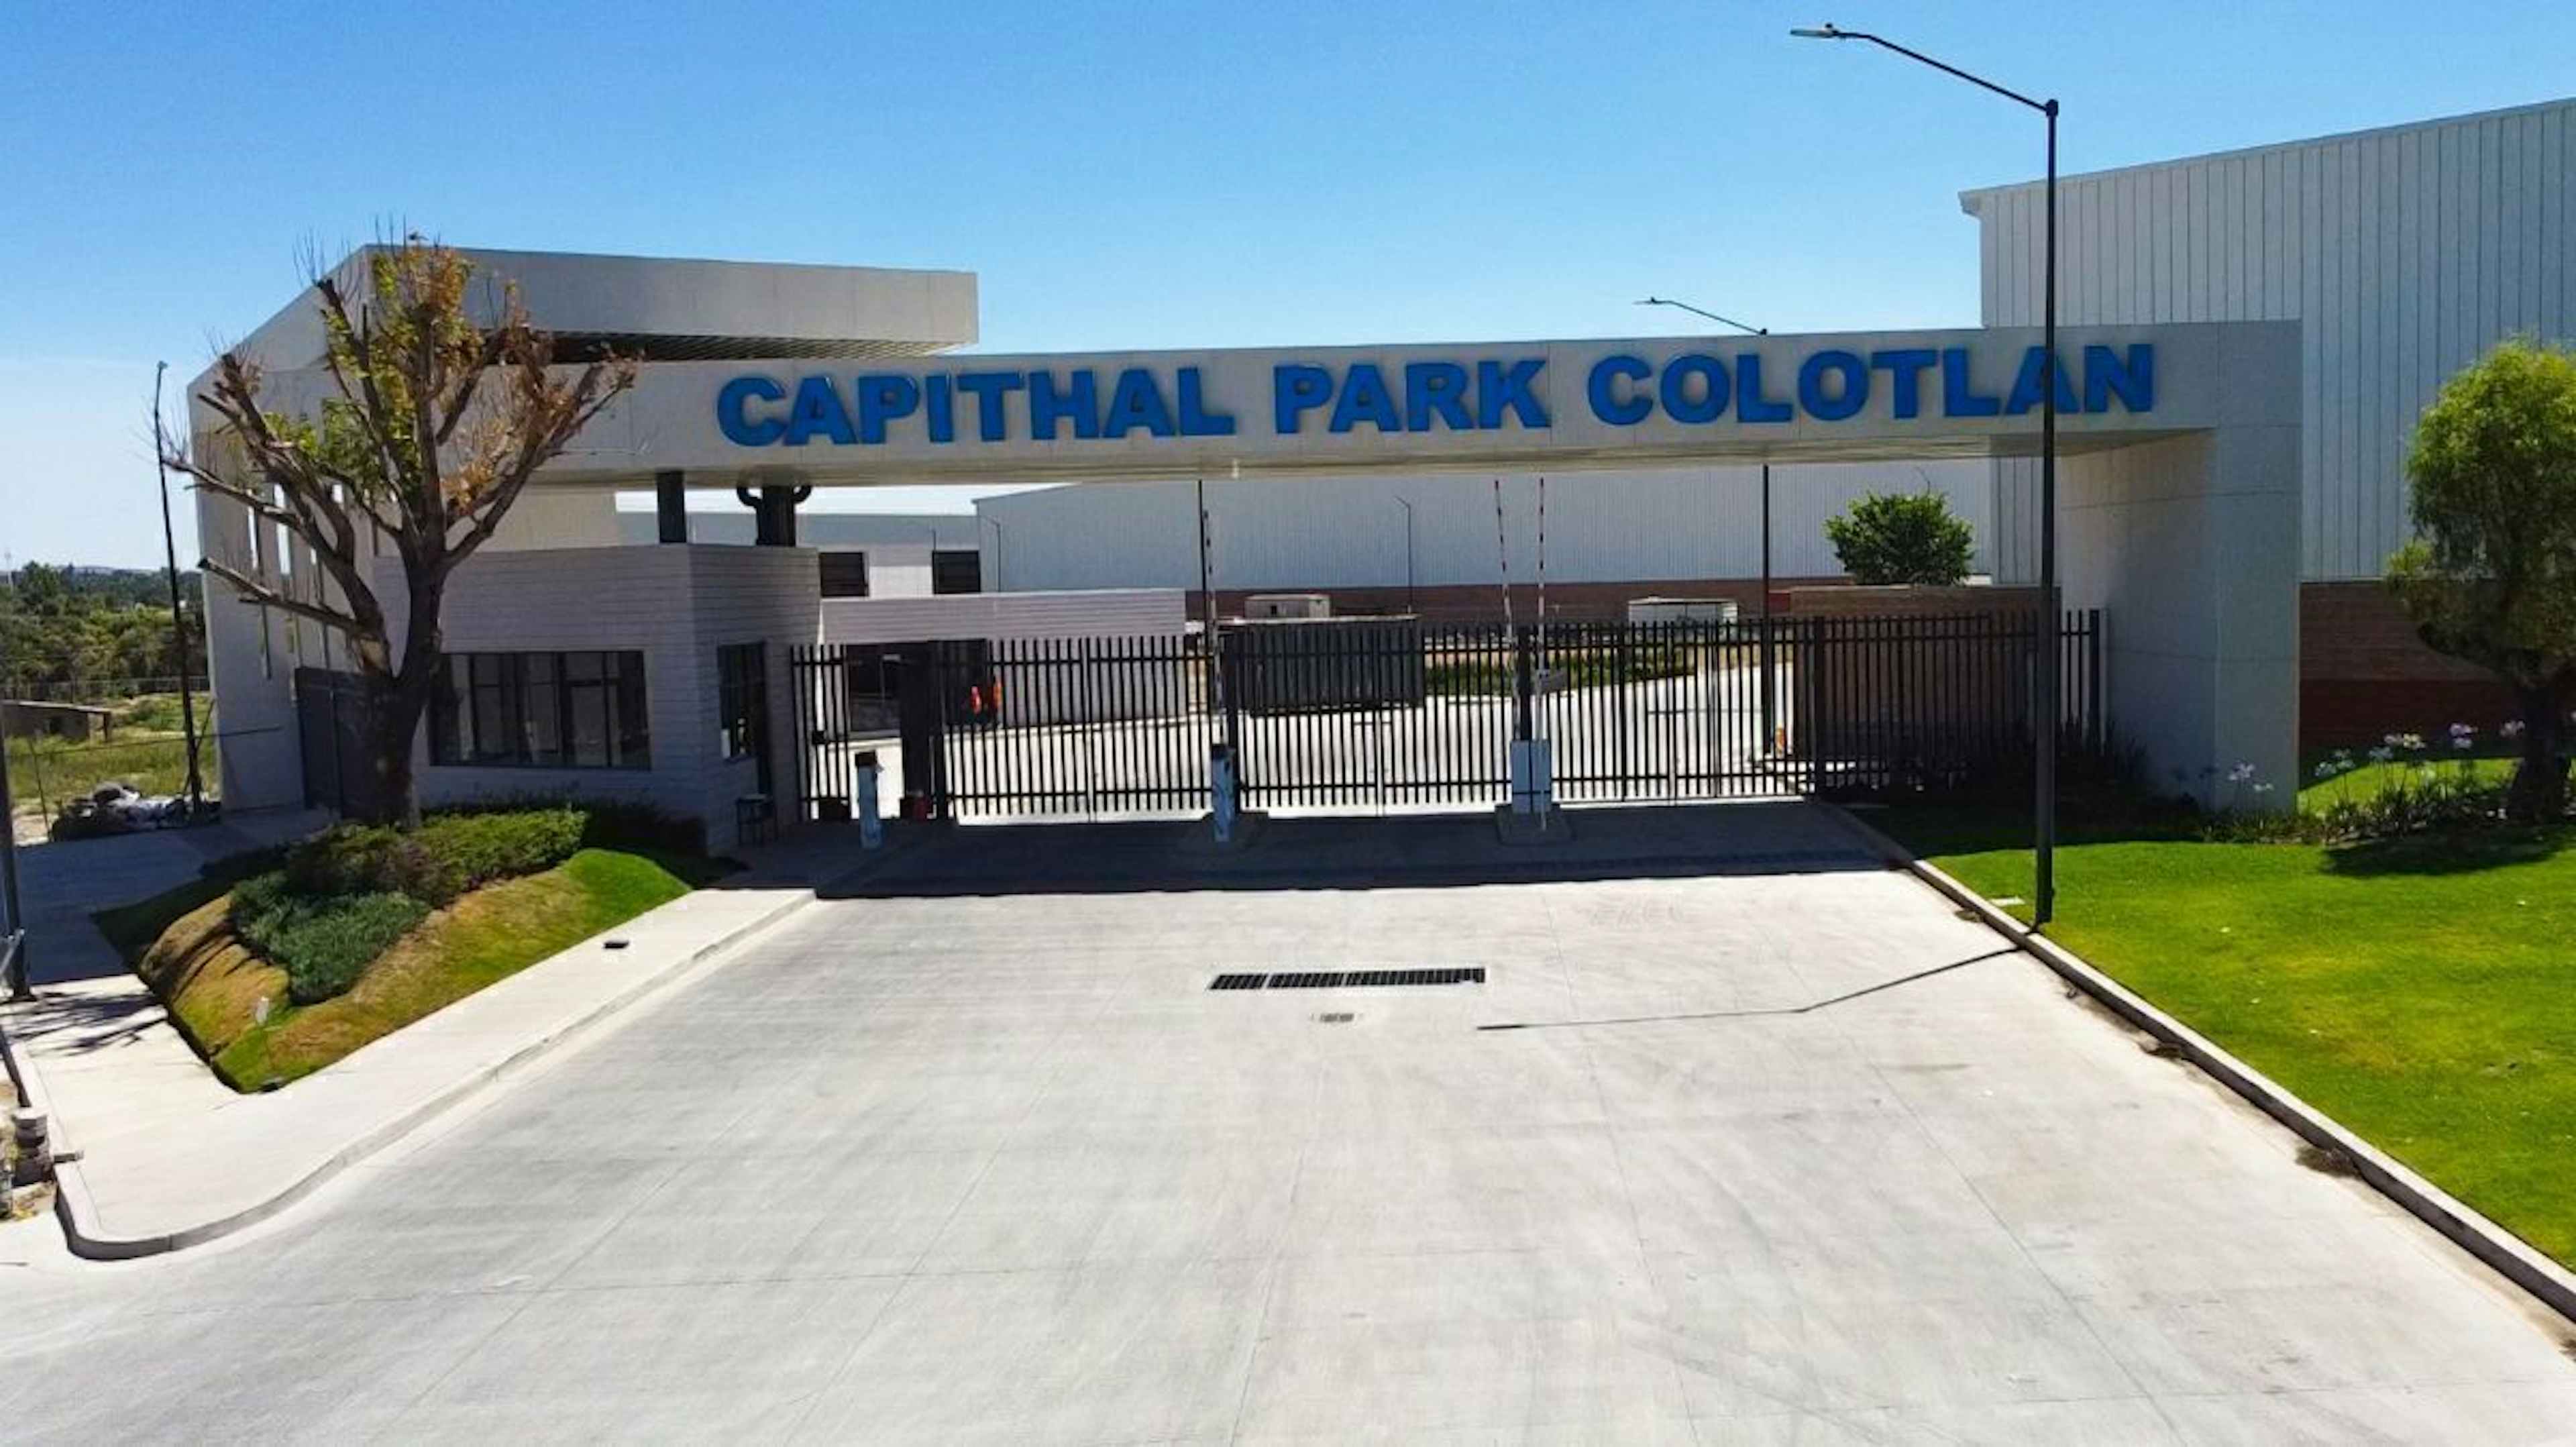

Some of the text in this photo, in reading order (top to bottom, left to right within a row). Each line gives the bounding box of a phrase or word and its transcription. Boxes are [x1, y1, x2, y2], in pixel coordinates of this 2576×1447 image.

[716, 343, 2155, 447] CAPITHAL PARK COLOTLAN
